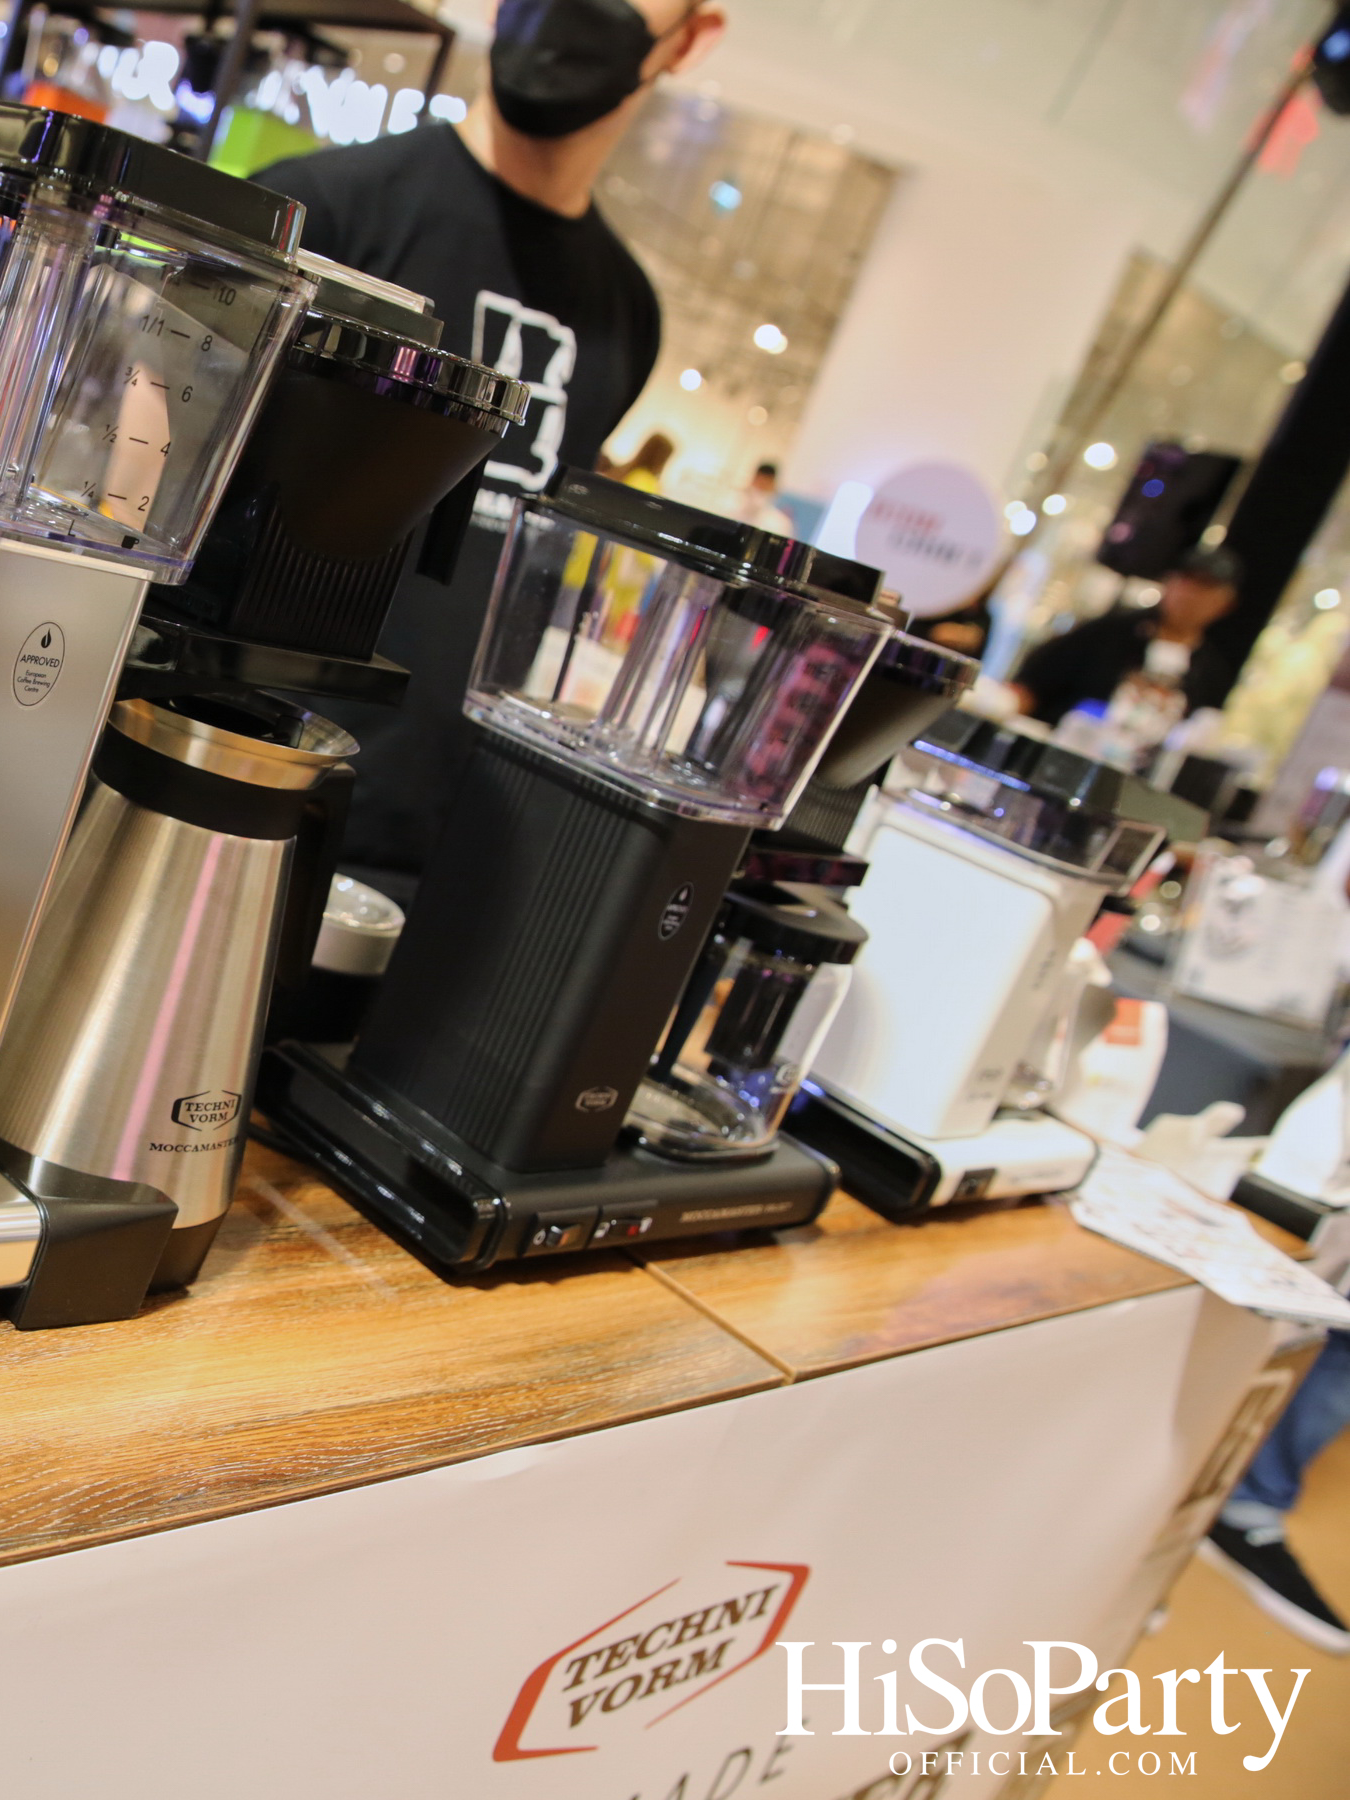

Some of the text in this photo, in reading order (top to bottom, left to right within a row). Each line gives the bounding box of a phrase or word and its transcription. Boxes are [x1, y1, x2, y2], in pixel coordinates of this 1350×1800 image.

[140, 314, 213, 352] 1/1 8
[181, 385, 194, 403] 6
[161, 440, 172, 458] 4
[137, 496, 149, 512] 2
[20, 654, 60, 668] APPROVED
[25, 669, 47, 679] European
[185, 1099, 235, 1112] TECHNI
[189, 1111, 228, 1123] VORM
[561, 1583, 781, 1692] TECHNI
[568, 1637, 736, 1729] VORM
